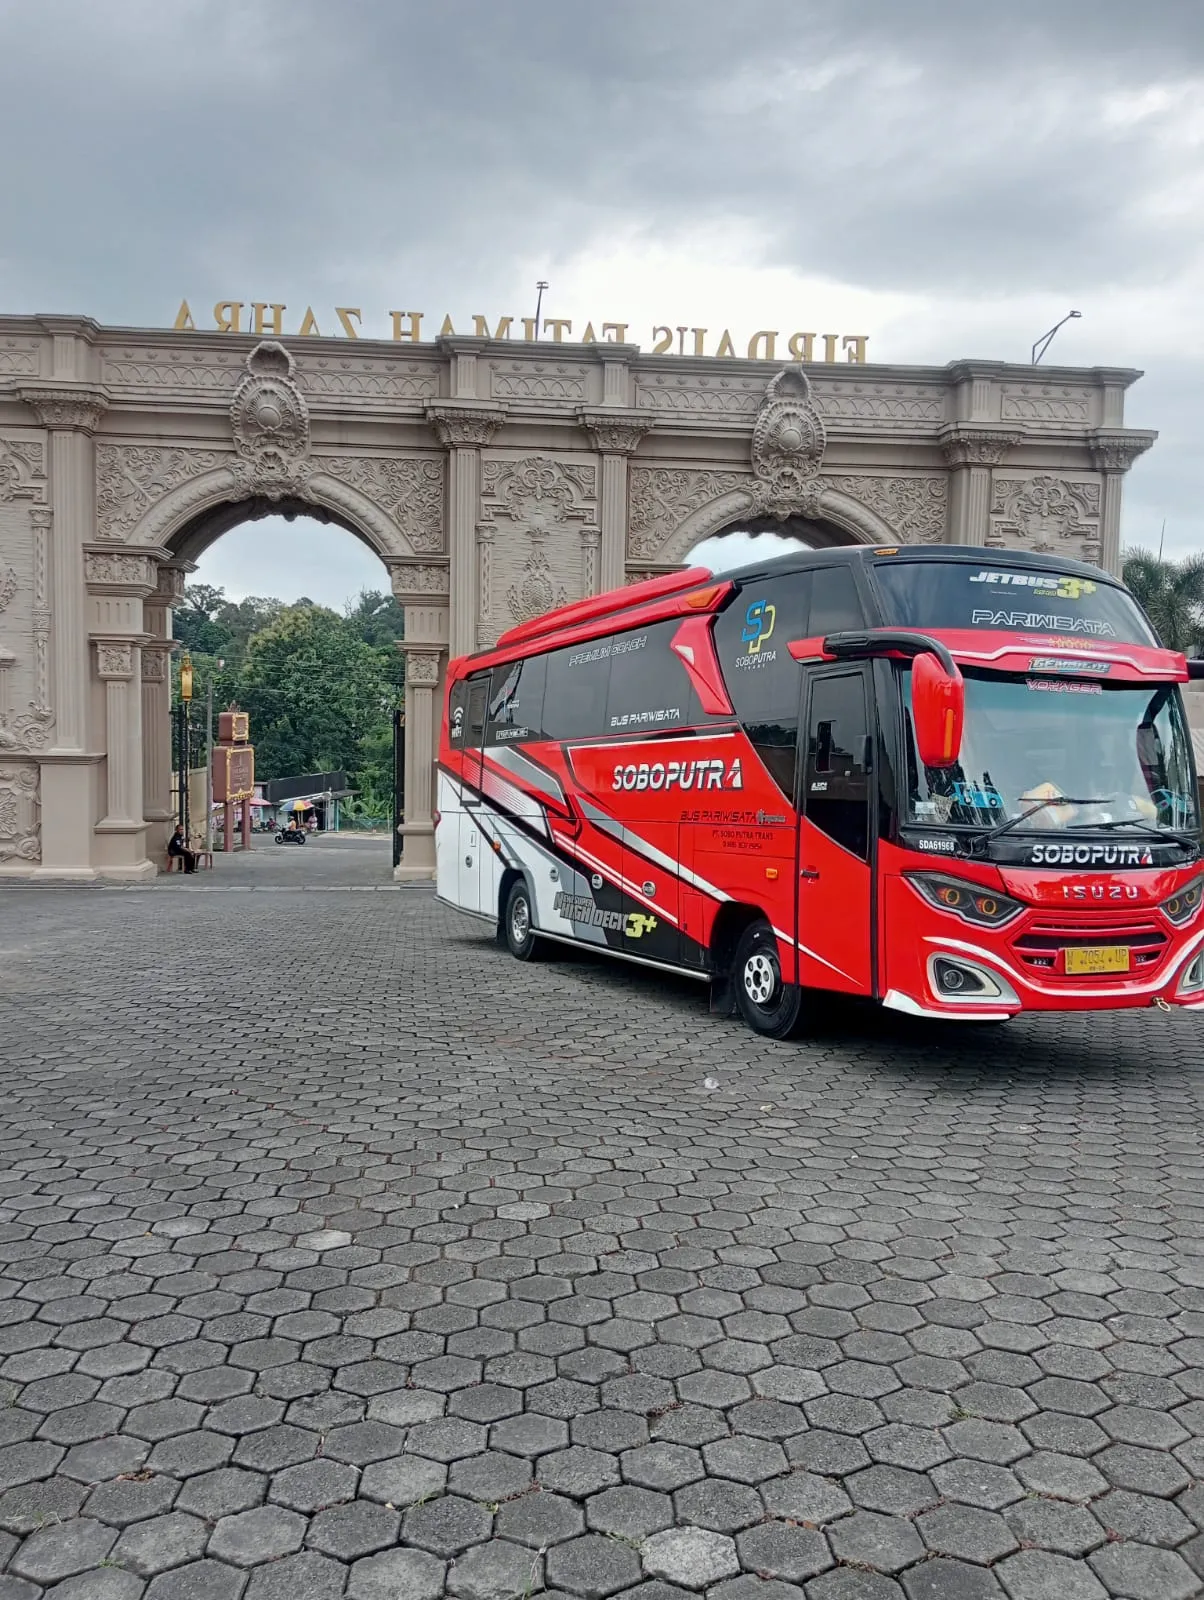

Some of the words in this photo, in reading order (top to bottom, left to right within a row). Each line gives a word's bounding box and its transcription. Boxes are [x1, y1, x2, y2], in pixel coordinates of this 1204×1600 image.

[969, 571, 1058, 589] JETBUS
[972, 610, 1116, 636] PARIWISATA
[735, 651, 777, 667] SOBOPUTRA
[1026, 679, 1102, 695] VOYAGER
[611, 715, 629, 726] BUS
[629, 708, 680, 724] PARIWISATA
[612, 758, 743, 790] SOBOPUTRA
[680, 810, 701, 821] BUS
[701, 811, 757, 824] PARIWISATA
[1031, 844, 1153, 864] SOBOPUTRA
[1063, 885, 1138, 899] ISUZU
